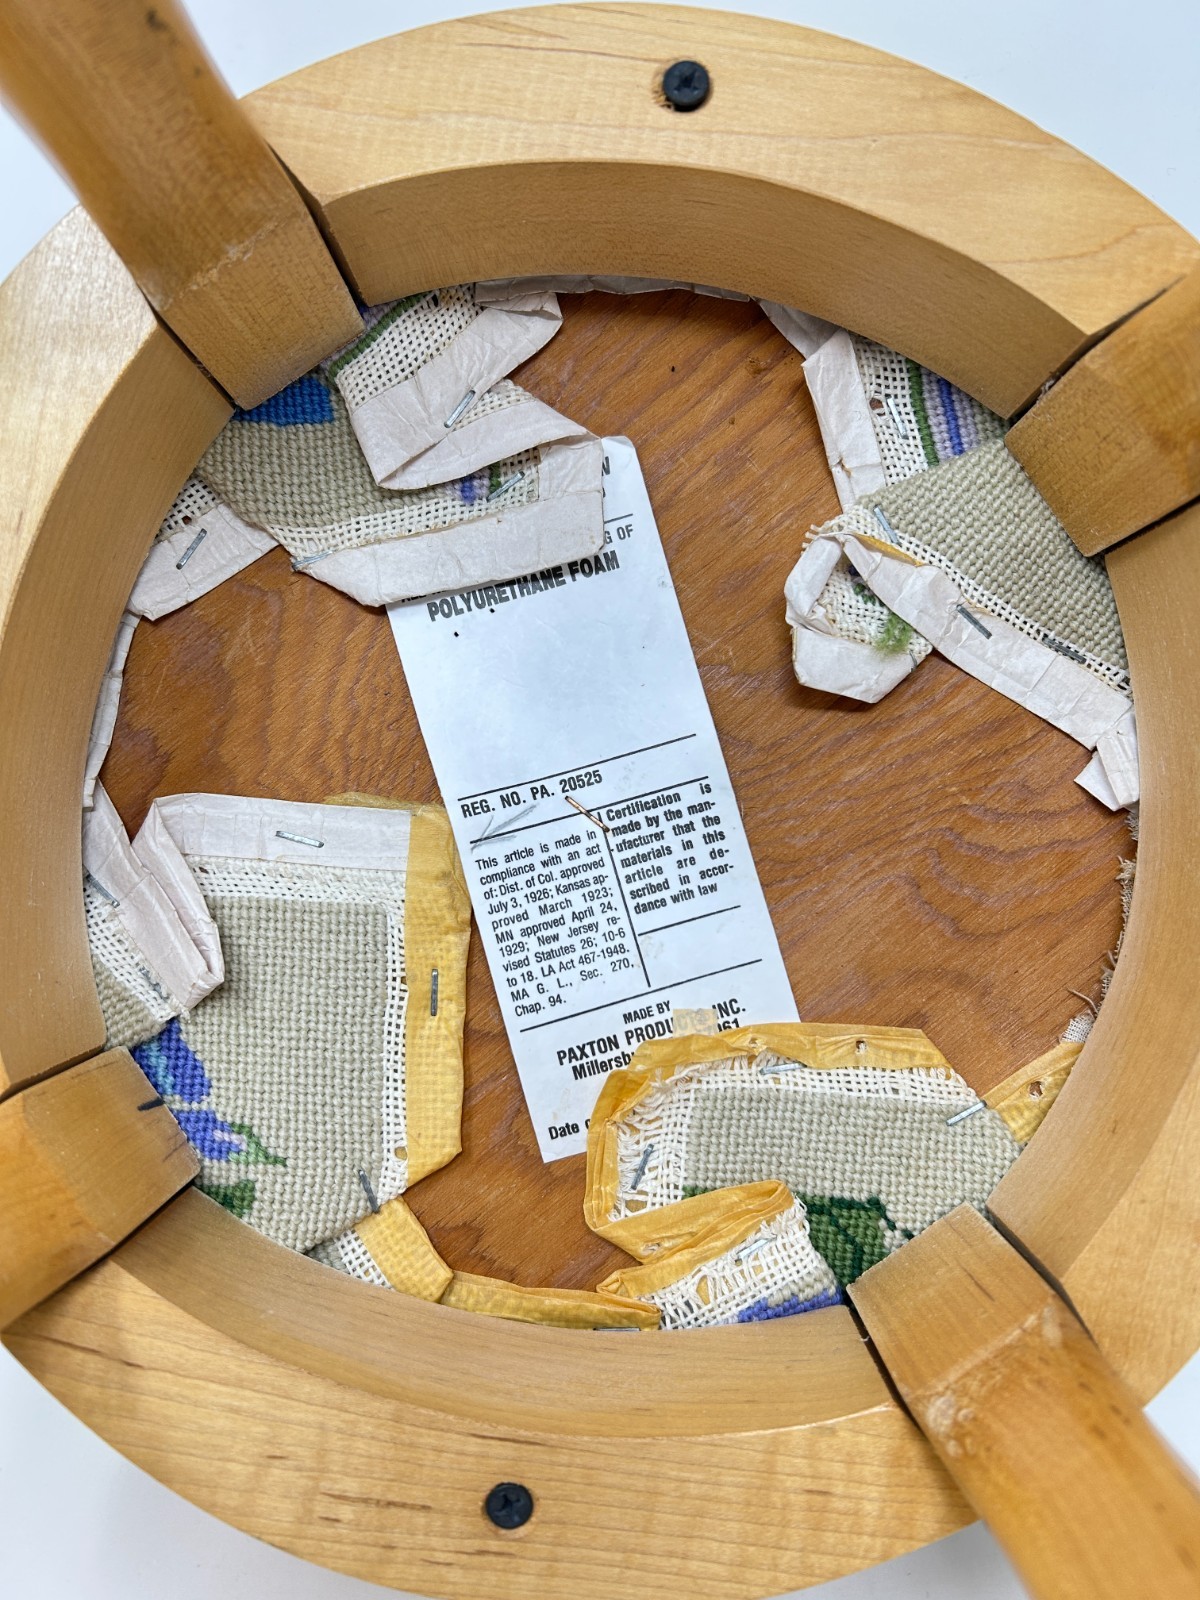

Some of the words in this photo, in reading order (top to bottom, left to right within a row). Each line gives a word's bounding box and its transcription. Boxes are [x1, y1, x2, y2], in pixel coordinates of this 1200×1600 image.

[616, 524, 634, 541] OF
[427, 566, 566, 621] POLYURETHANE
[570, 550, 620, 582] FOAM
[461, 799, 495, 818] REG.
[500, 791, 526, 809] NO.
[530, 784, 554, 801] PA.
[560, 769, 603, 793] 20525
[606, 792, 681, 822] Certification
[700, 783, 712, 795] is
[611, 820, 641, 838] made
[645, 815, 660, 828] by
[664, 808, 683, 822] the
[687, 801, 716, 816] man-
[616, 830, 664, 853] ufacturer
[672, 820, 696, 836] that
[702, 815, 720, 828] the
[475, 857, 498, 871] This
[504, 848, 534, 863] article
[540, 843, 550, 854] is
[555, 834, 582, 850] made
[586, 830, 596, 840] in
[480, 862, 536, 886] compliance
[540, 854, 562, 868] with
[568, 850, 580, 861] an
[586, 843, 602, 857] act
[620, 845, 672, 868] materials
[682, 839, 694, 851] in
[703, 830, 726, 845] this
[624, 865, 664, 884] article
[676, 856, 696, 869] are
[709, 848, 730, 860] de-
[484, 886, 498, 900] of:
[500, 879, 523, 896] Dist.
[525, 876, 536, 888] of
[537, 870, 558, 886] Col.
[560, 857, 605, 880] approved
[488, 900, 509, 915] July
[510, 897, 522, 908] 3,
[524, 888, 554, 904] 1926;
[555, 876, 592, 895] Kansas
[592, 874, 608, 887] ap-
[630, 878, 670, 900] scribed
[679, 874, 690, 886] in
[700, 864, 734, 880] accor-
[492, 910, 529, 932] proved
[538, 897, 573, 916] March
[582, 886, 614, 904] 1923;
[634, 897, 667, 914] dance
[670, 888, 695, 904] with
[698, 882, 718, 896] law
[495, 929, 514, 944] MN
[520, 914, 566, 938] approved
[572, 906, 594, 923] April
[499, 940, 530, 958] 1929;
[537, 932, 560, 946] New
[567, 921, 599, 938] Jersey
[606, 914, 621, 926] re-
[502, 956, 530, 972] vised
[534, 944, 576, 963] Statutes
[580, 936, 598, 950] 26;
[602, 927, 626, 943] 10-6
[506, 976, 518, 988] to
[520, 970, 538, 983] 18.
[540, 964, 556, 978] LA
[558, 958, 576, 973] Act
[578, 943, 630, 966] 467-1948.
[510, 988, 530, 1002] MA
[536, 982, 549, 994] G.
[557, 977, 572, 989] L.,
[580, 968, 602, 982] Sec.
[514, 1001, 546, 1017] Chap.
[548, 994, 566, 1007] 94.
[623, 1006, 654, 1024] MADE
[656, 1000, 671, 1014] BY
[556, 1034, 620, 1066] PAXTON
[624, 1017, 674, 1046] PRODU
[572, 1051, 635, 1080] Millersb
[548, 1122, 580, 1140] Date
